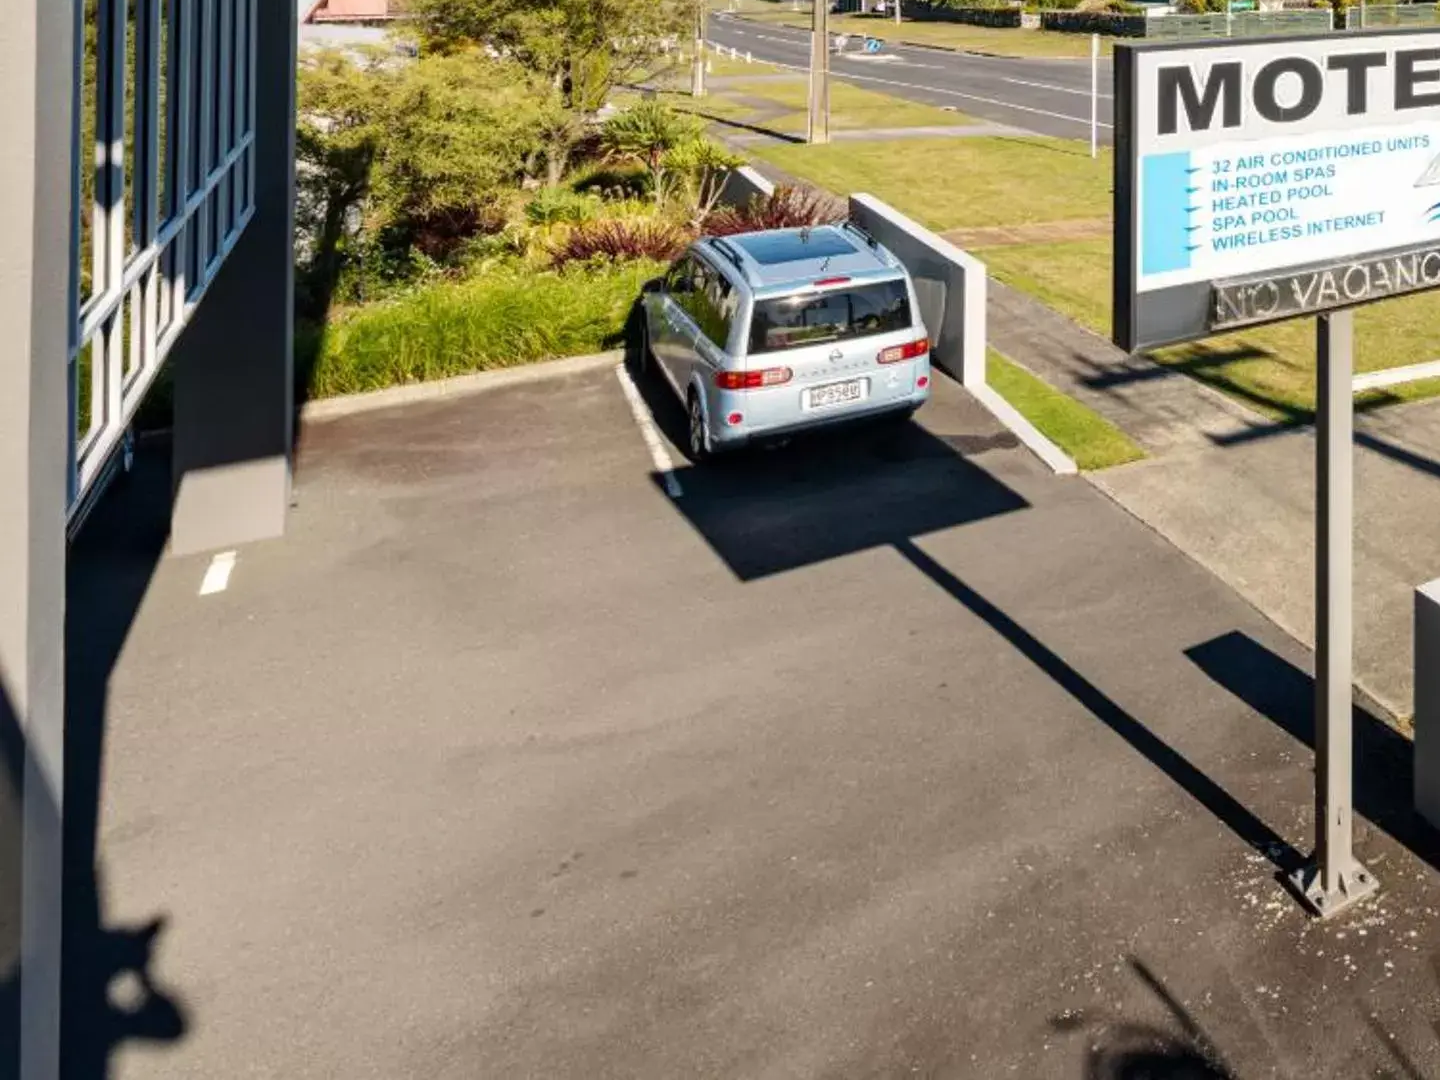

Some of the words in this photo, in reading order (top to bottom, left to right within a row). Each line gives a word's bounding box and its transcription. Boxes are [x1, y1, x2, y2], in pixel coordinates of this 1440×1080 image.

[1212, 159, 1231, 174] 32
[1236, 154, 1265, 172] AIR
[1269, 140, 1382, 167] CONDITIONED
[1387, 134, 1430, 152] UNITS
[1211, 170, 1288, 193] IN-ROOM
[1293, 163, 1336, 182] SPAS
[1211, 190, 1282, 213] HEATED
[1287, 183, 1333, 201] POOL
[1211, 215, 1247, 232] SPA
[1251, 207, 1300, 226] POOL
[1211, 224, 1303, 252] WIRELESS
[1306, 210, 1386, 236] INTERNET
[1216, 280, 1280, 321] NO
